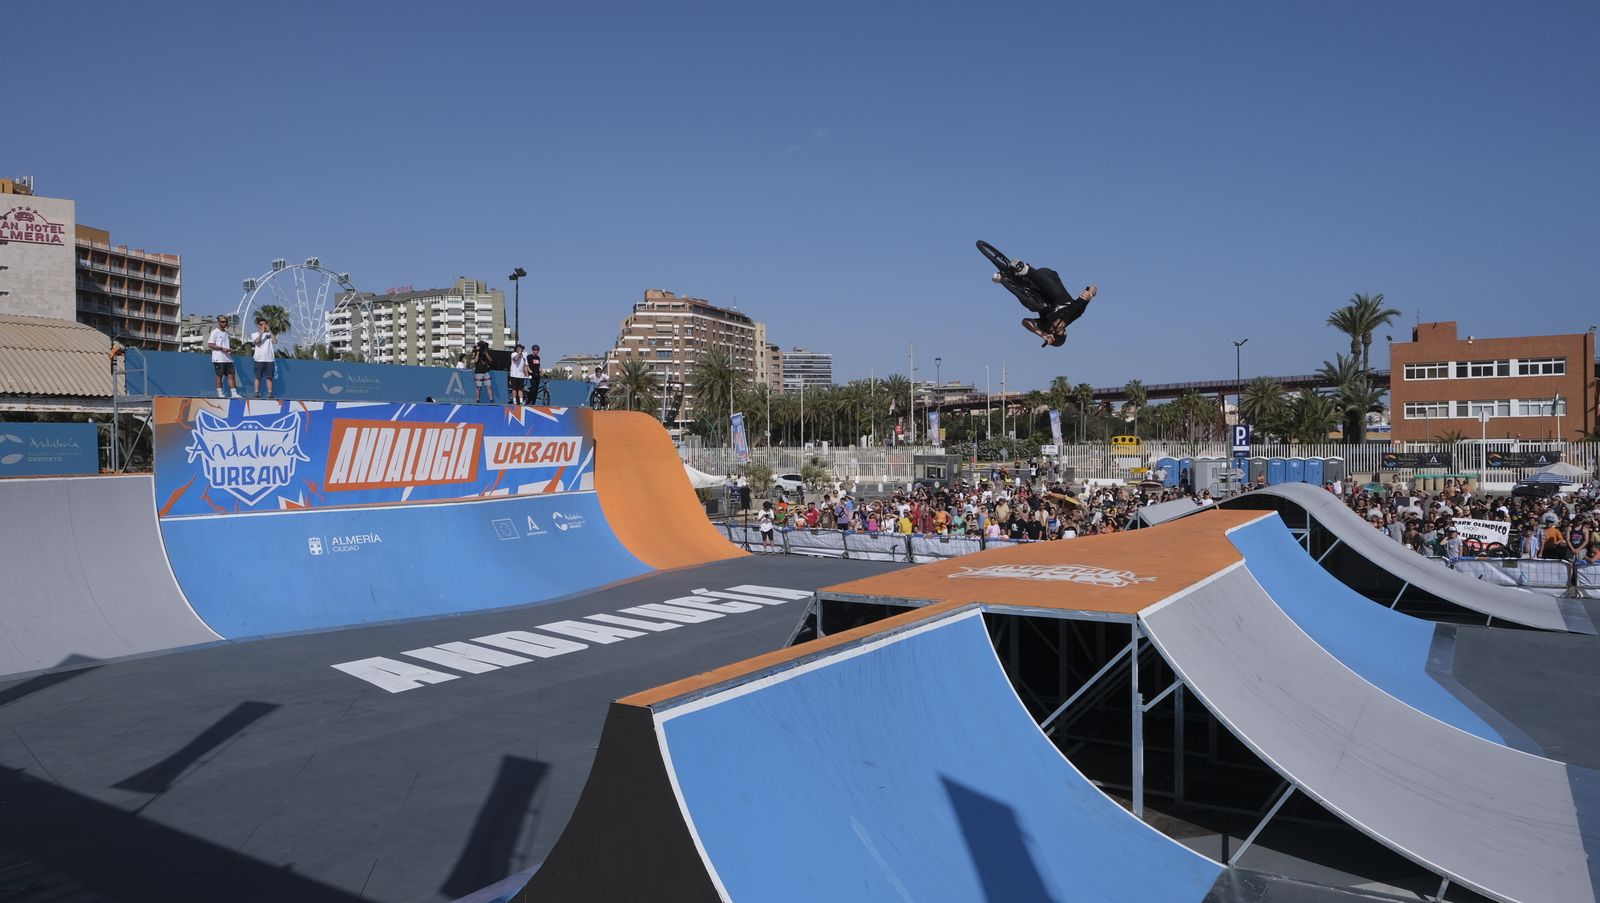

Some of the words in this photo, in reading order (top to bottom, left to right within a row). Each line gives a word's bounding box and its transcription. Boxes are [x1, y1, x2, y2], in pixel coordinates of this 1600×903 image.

[26, 224, 65, 234] HOTEL
[29, 437, 80, 449] Andalucía
[187, 430, 310, 463] Andalucía
[329, 422, 477, 484] ANDALUCÍA
[493, 442, 576, 464] URBAN
[211, 465, 289, 486] URBAN
[332, 532, 382, 546] ALMERÍA
[333, 545, 359, 553] CIUDAD
[330, 585, 814, 693] ANDALUCÍA
